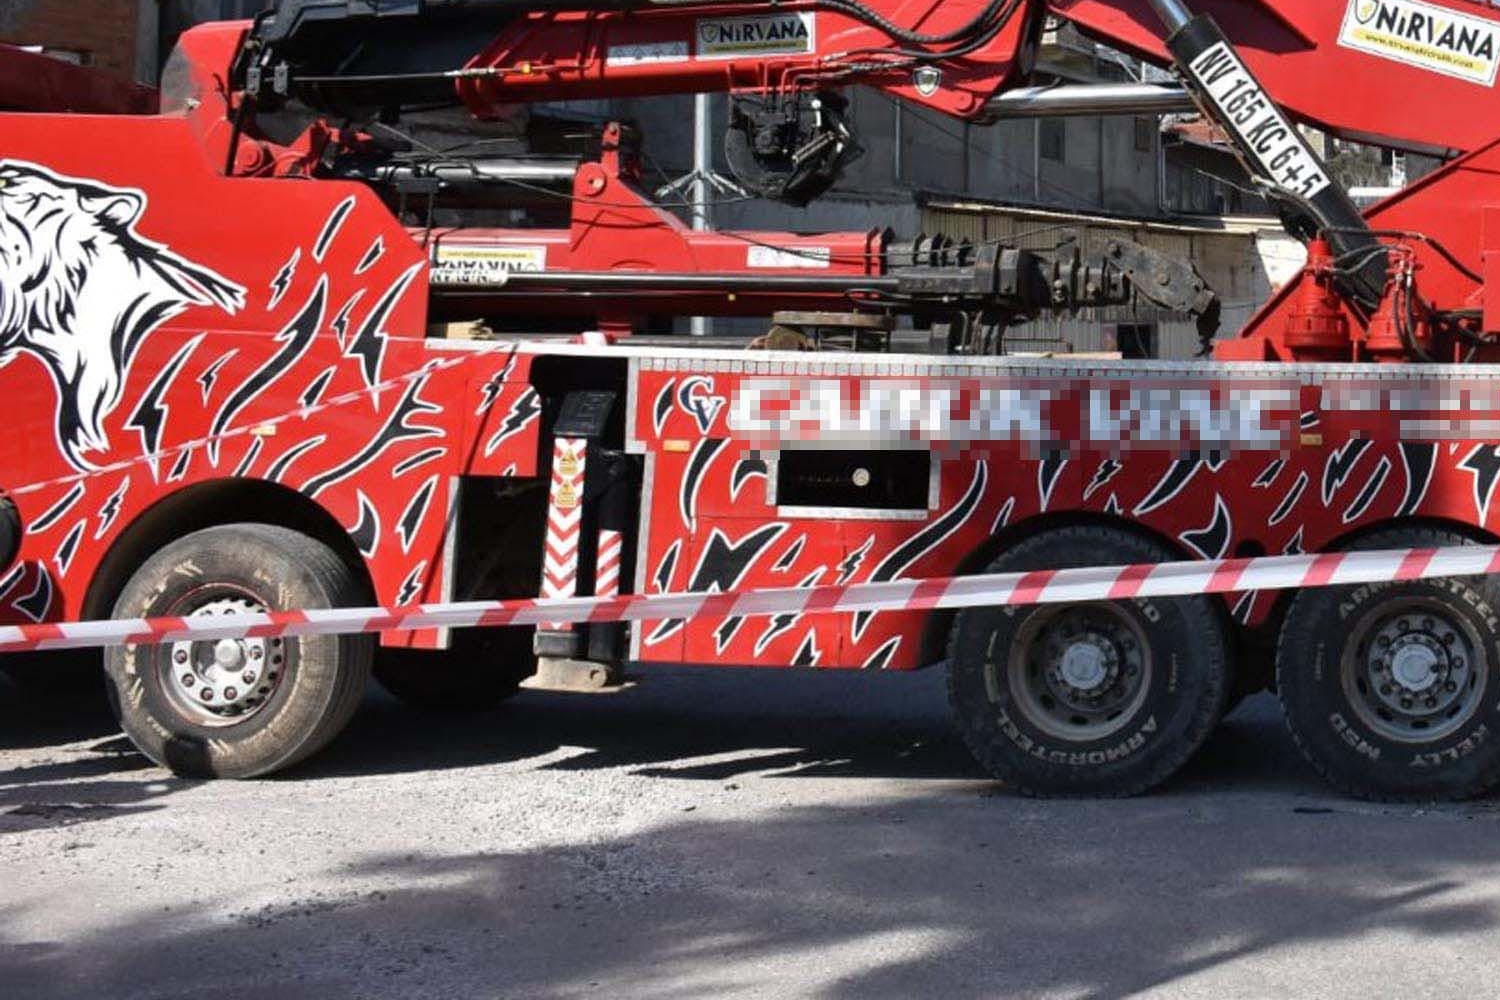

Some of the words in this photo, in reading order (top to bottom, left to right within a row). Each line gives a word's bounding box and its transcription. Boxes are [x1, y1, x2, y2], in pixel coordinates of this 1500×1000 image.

[1195, 48, 1237, 85] NV
[1219, 79, 1265, 125] 165
[1246, 115, 1288, 154] KC
